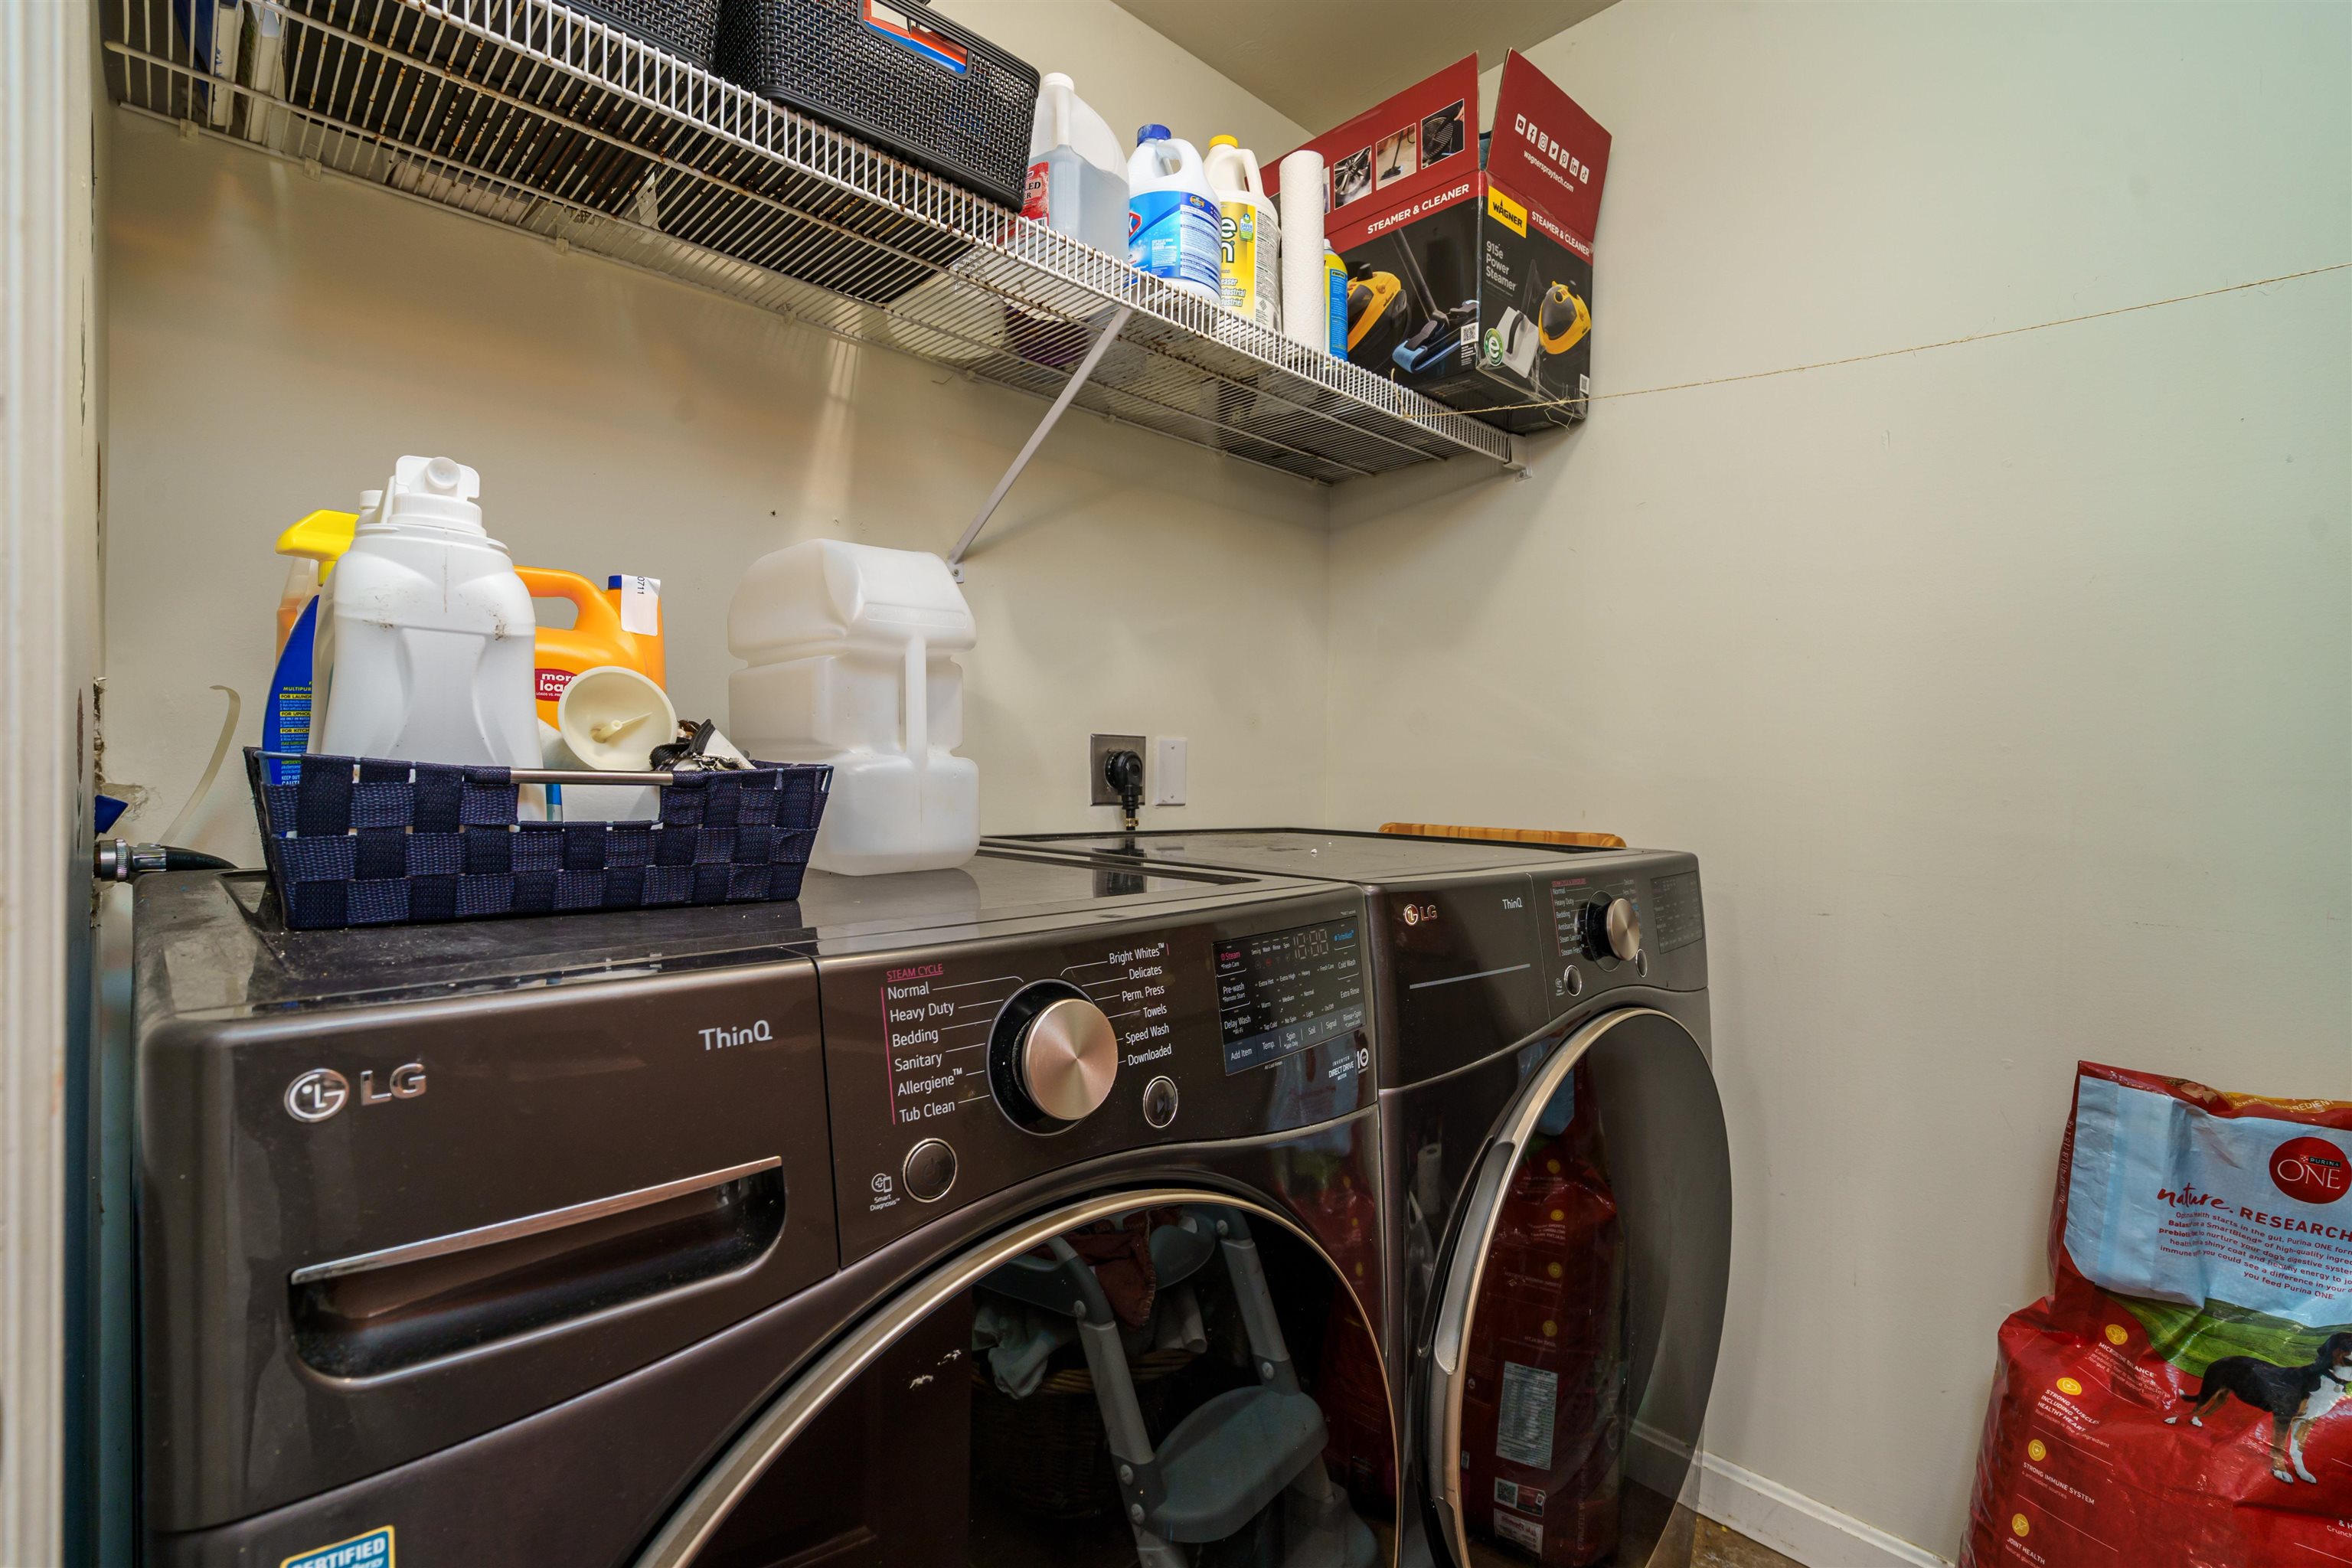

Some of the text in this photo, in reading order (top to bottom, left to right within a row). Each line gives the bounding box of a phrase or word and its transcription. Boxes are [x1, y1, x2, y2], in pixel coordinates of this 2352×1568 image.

[1524, 150, 1574, 193] wagnerspraytech.com
[1367, 184, 1469, 234] STEAMER & CLEANER
[1493, 200, 1523, 228] WAGNER
[1531, 211, 1590, 256] STEAMER & CLEANER
[1486, 240, 1504, 259] 915e
[1486, 253, 1510, 275] Power
[1485, 266, 1517, 291] Steamer
[540, 679, 564, 692] loa
[1419, 897, 1523, 921] LG ThinQ
[1556, 910, 1570, 919] Bedding
[1109, 950, 1133, 965] Bright
[1225, 952, 1240, 960] Steam
[887, 963, 943, 981] STEAM CYCLE
[1129, 966, 1162, 980] Delicates
[888, 981, 929, 1000] Normal
[1122, 985, 1165, 1001] Perm. Press
[1223, 982, 1244, 995] Pre-wash
[1340, 990, 1350, 998] Extra
[890, 1002, 955, 1022] Heavy Duty
[1143, 1003, 1168, 1018] Towels
[1223, 1015, 1251, 1030] Delay Wash
[1308, 1026, 1316, 1035] Soil
[1325, 1018, 1337, 1030] Signal
[892, 1029, 939, 1047] Bedding
[1125, 1023, 1170, 1045] Speed Wash
[1286, 1032, 1296, 1041] Spin
[360, 1019, 773, 1106] LG ThinQ
[894, 1054, 942, 1072] Sanitary
[1128, 1043, 1172, 1066] Downloaded
[1230, 1048, 1253, 1060] Add Item
[1332, 1055, 1350, 1066] INVERTER
[1328, 1065, 1343, 1078] DIRECT
[1343, 1060, 1354, 1073] DRIVE
[899, 1102, 956, 1122] Tub Clean
[2309, 1157, 2339, 1167] PURINA
[2277, 1158, 2341, 1190] ONE
[874, 1194, 891, 1204] Smart
[2212, 1215, 2238, 1227] starts
[2251, 1228, 2265, 1237] the
[2268, 1234, 2284, 1243] gut.
[2287, 1237, 2312, 1247] Purina
[2314, 1243, 2333, 1251] ONE
[2204, 1240, 2226, 1250] shiny
[2227, 1247, 2246, 1256] coat
[2249, 1253, 2265, 1263] and
[2300, 1267, 2330, 1280] energy
[2206, 1232, 2238, 1245] nurture
[2240, 1243, 2260, 1253] your
[2287, 1256, 2323, 1269] digestive
[2275, 1244, 2324, 1259] high-quality
[2217, 1252, 2242, 1264] could
[2243, 1261, 2259, 1271] see
[2269, 1269, 2313, 1286] difference
[2326, 1284, 2346, 1292] your
[2243, 1271, 2335, 1300] you feed Purina ONE.
[2041, 1395, 2074, 1416] INCLUDING
[2045, 1390, 2071, 1406] STRONG
[2037, 1401, 2086, 1432] HEALTHY HEART
[2023, 1462, 2095, 1505] STRONG IMMUNE SYSTEM
[2007, 1537, 2045, 1565] JOINT HEALTH
